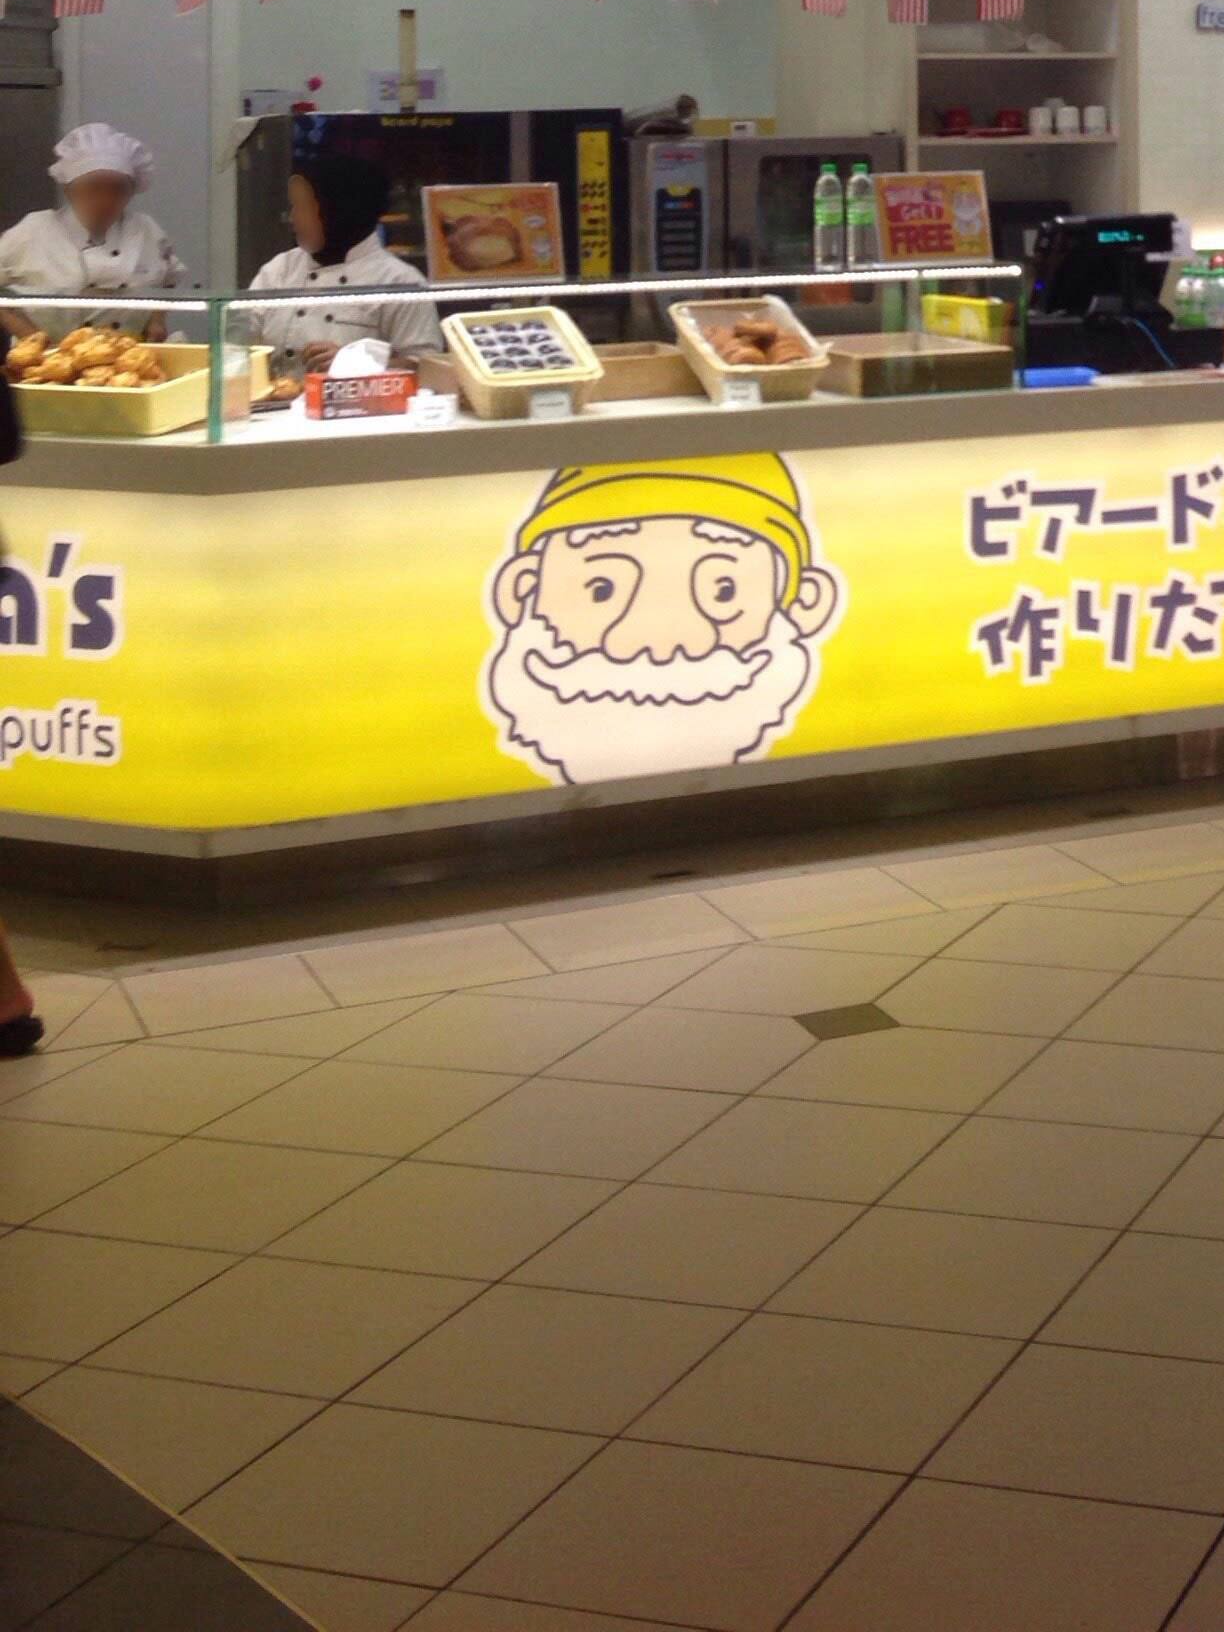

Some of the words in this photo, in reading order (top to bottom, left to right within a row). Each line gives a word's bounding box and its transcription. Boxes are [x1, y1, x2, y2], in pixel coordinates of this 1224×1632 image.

[889, 224, 954, 256] FREE
[323, 377, 406, 398] PREMIER
[0, 706, 116, 760] puffs
